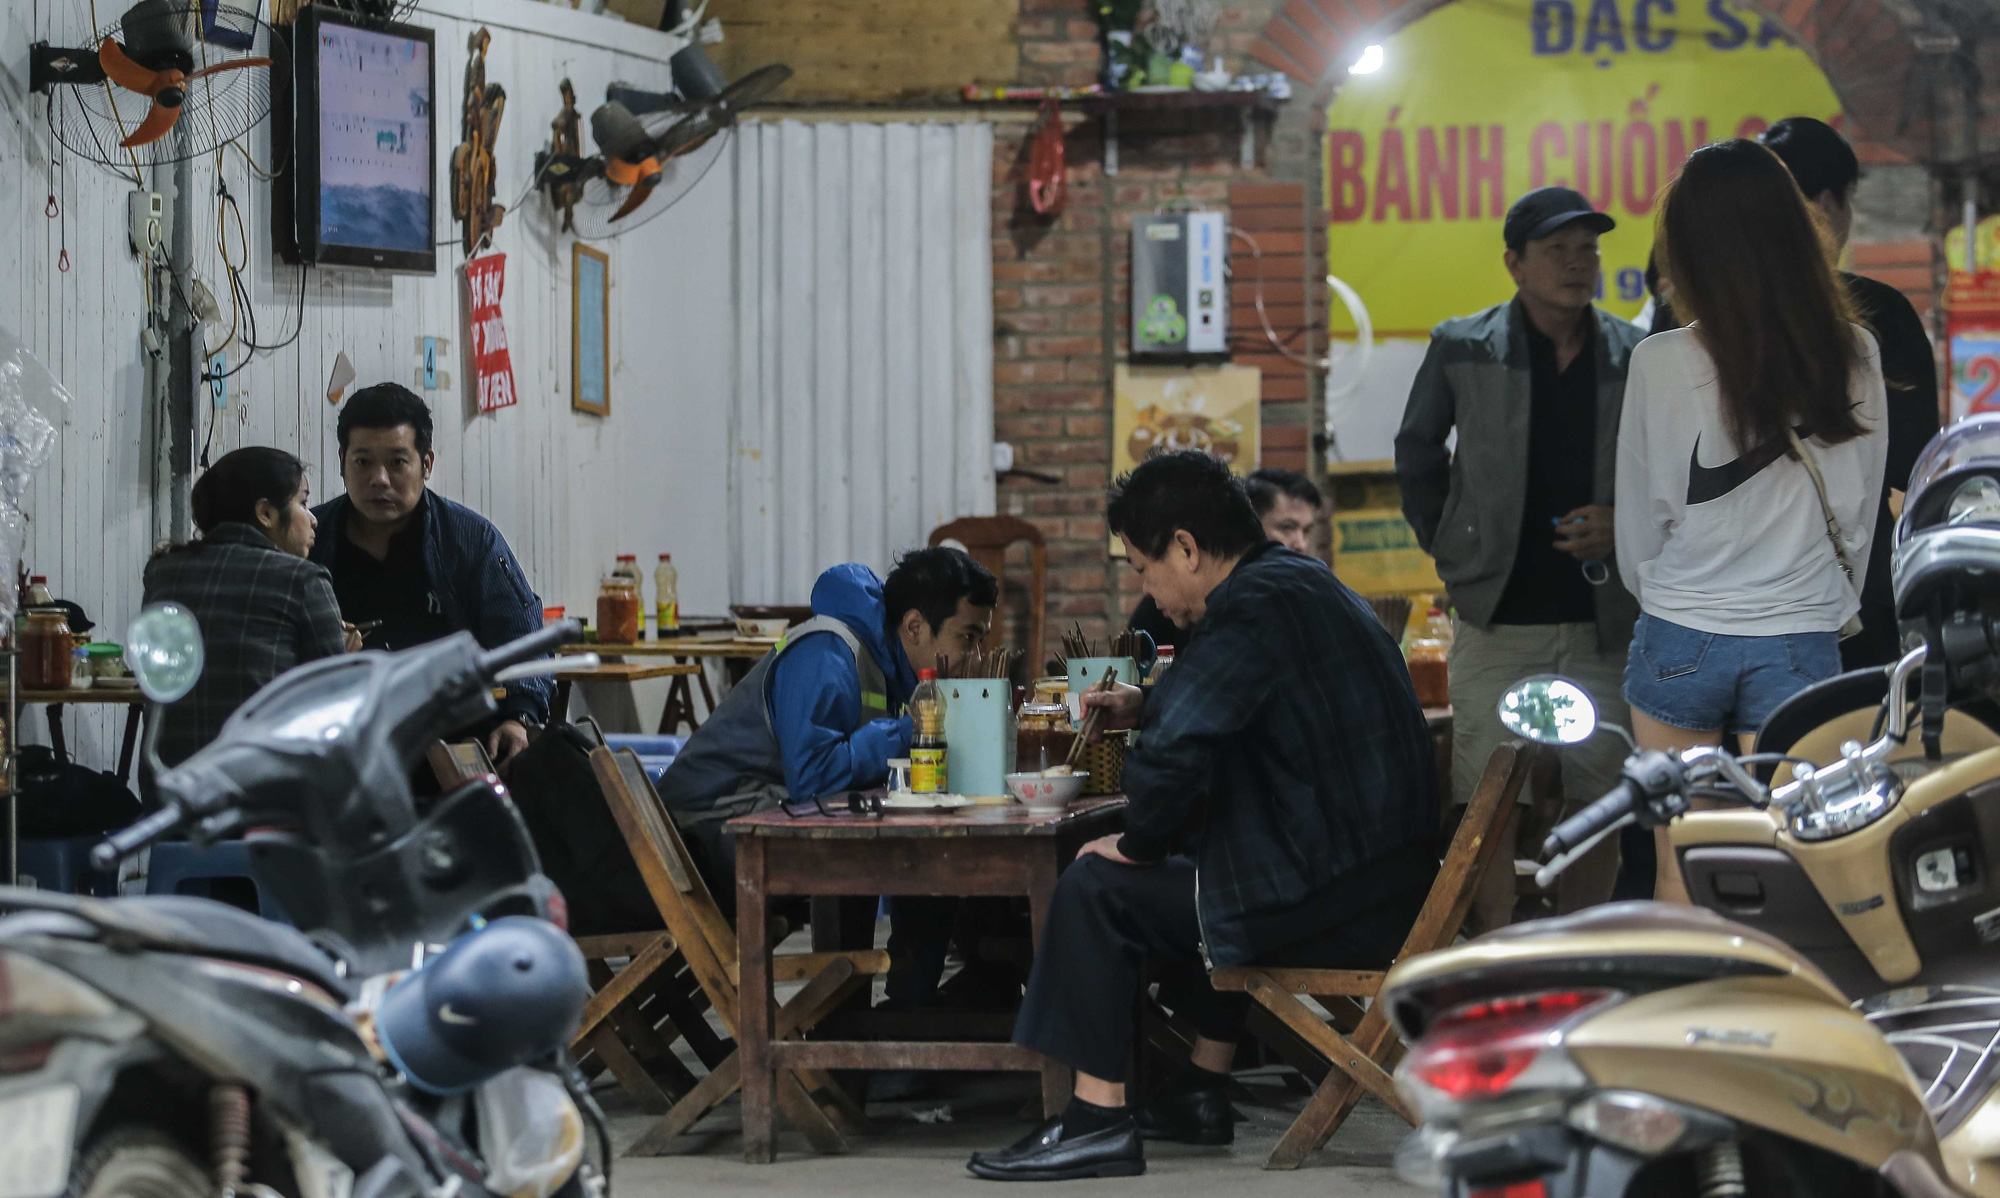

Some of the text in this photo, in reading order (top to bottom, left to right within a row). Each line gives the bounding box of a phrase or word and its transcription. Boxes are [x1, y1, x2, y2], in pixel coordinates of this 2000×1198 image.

[1328, 105, 1504, 222] BÁNH
[426, 346, 434, 379] 4
[215, 363, 223, 397] 3
